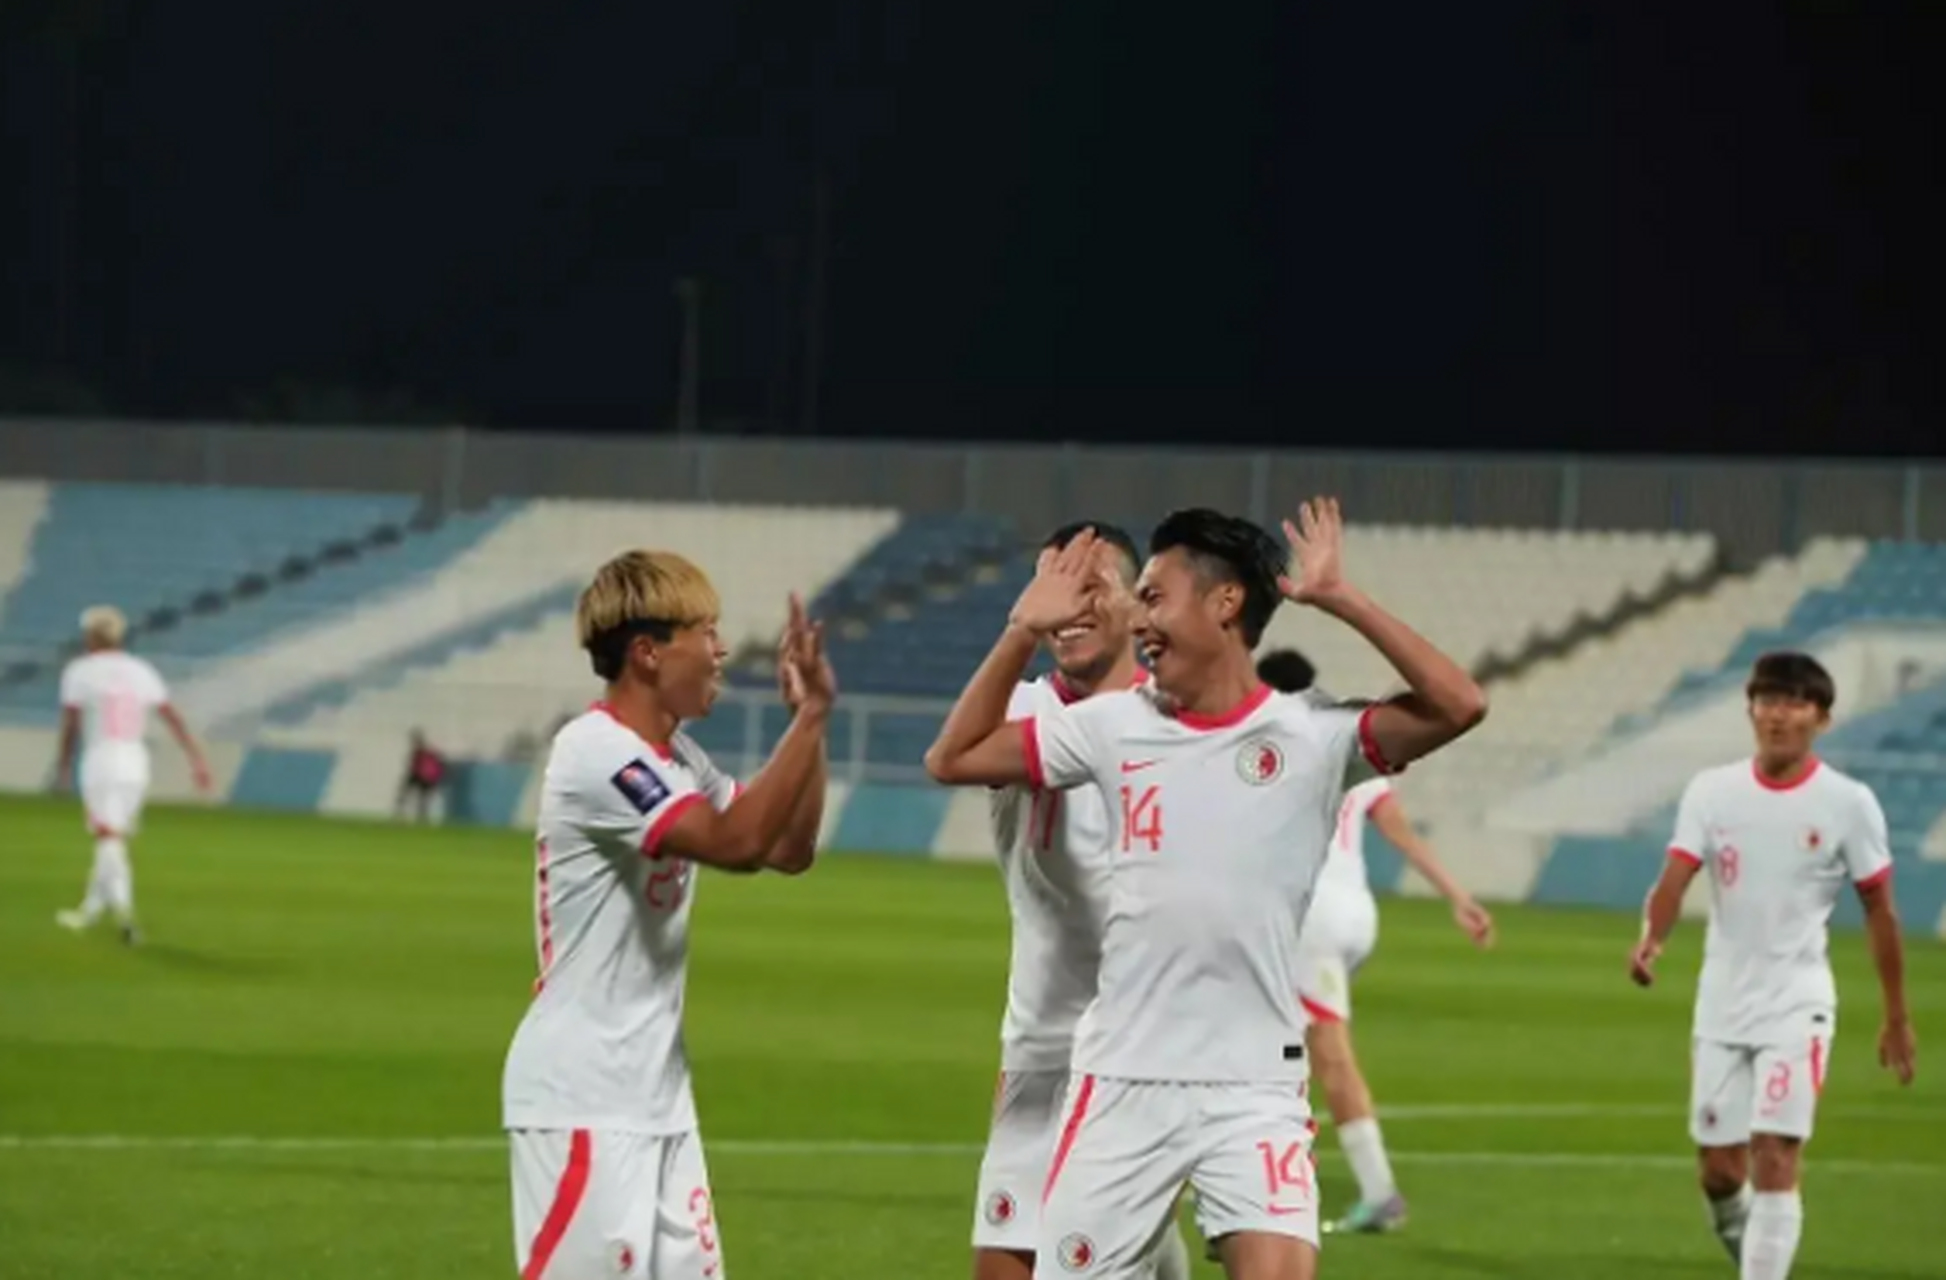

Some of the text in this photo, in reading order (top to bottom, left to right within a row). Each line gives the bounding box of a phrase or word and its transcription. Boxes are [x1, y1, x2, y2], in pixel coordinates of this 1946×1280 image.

[1120, 785, 1163, 851] 14
[1718, 845, 1737, 887] 8
[1766, 1061, 1789, 1102] 8
[1256, 1141, 1309, 1199] 14
